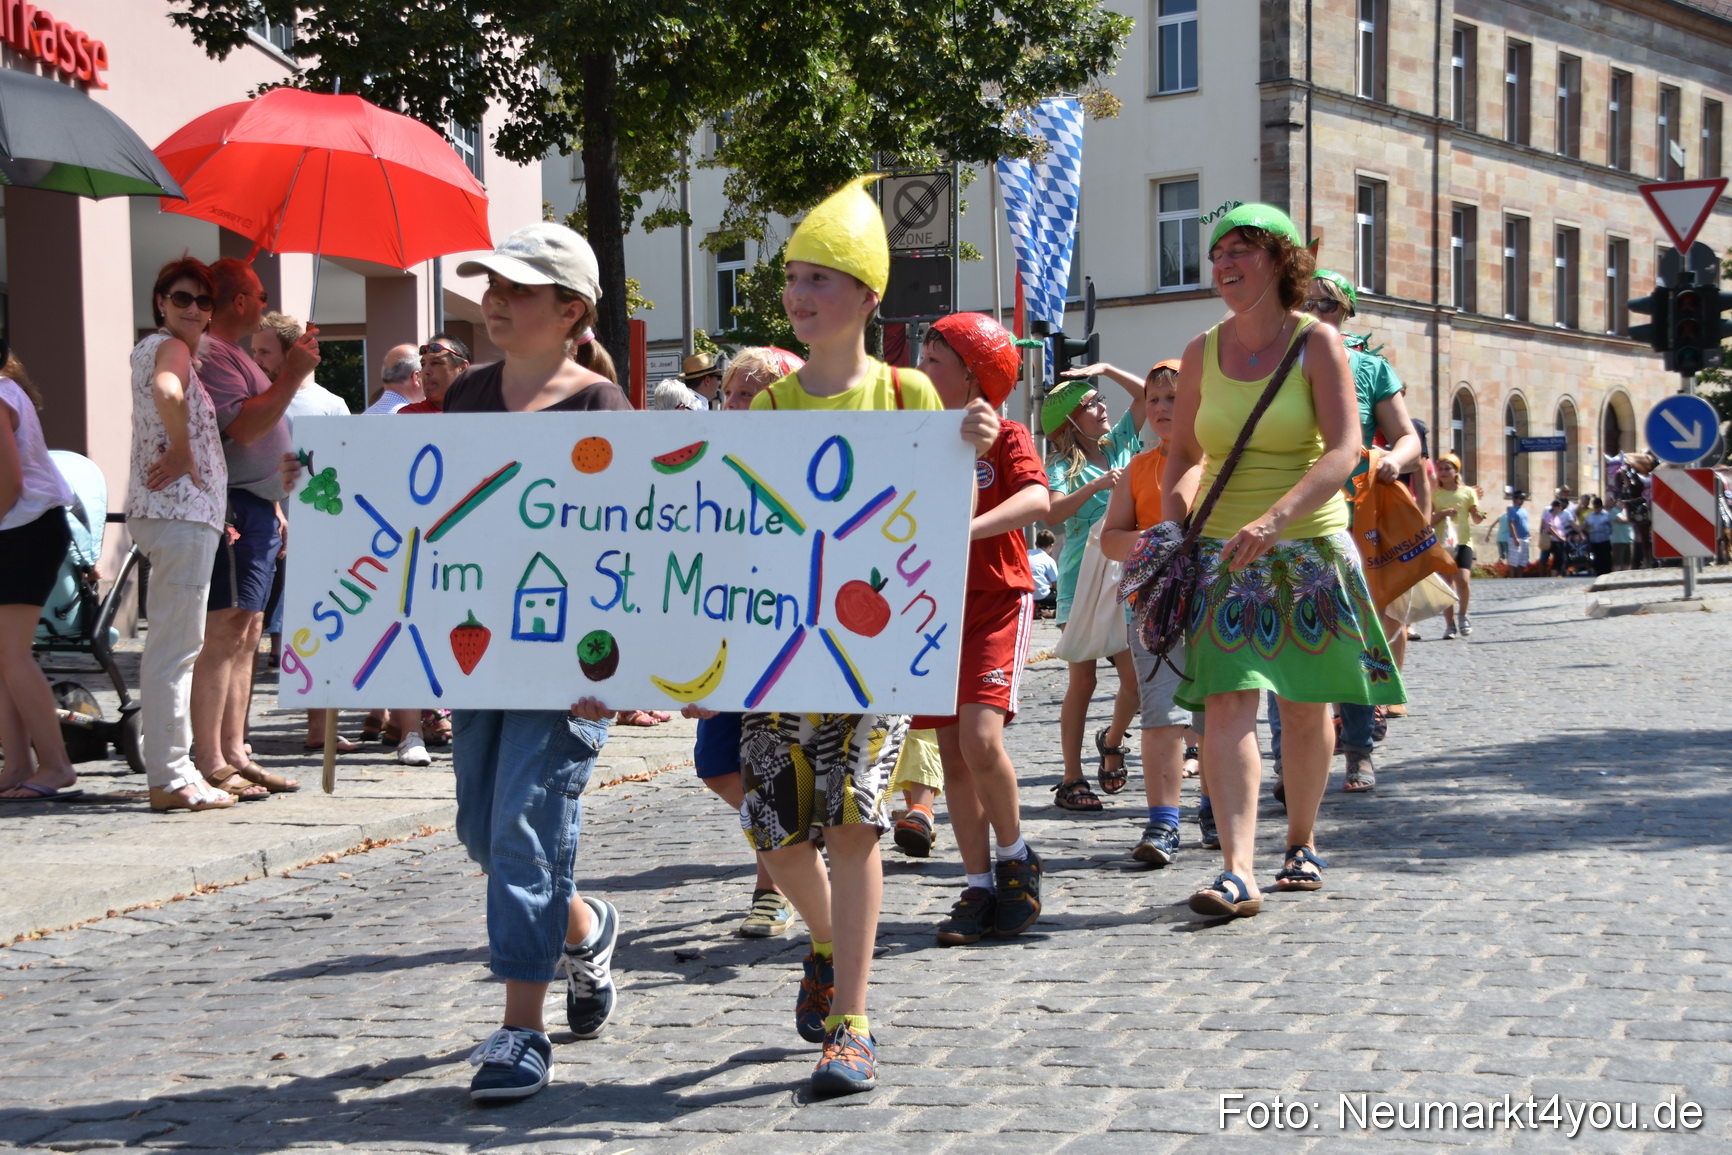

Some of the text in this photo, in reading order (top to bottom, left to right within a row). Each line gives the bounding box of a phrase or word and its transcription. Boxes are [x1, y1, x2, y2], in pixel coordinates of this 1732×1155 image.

[0, 0, 108, 90] rkasse
[898, 232, 933, 245] ZONE
[519, 478, 784, 536] Grundschule
[432, 549, 800, 630] im St. Marien
[881, 490, 948, 677] bunt
[1402, 537, 1436, 561] REISEN
[281, 493, 403, 695] gesund
